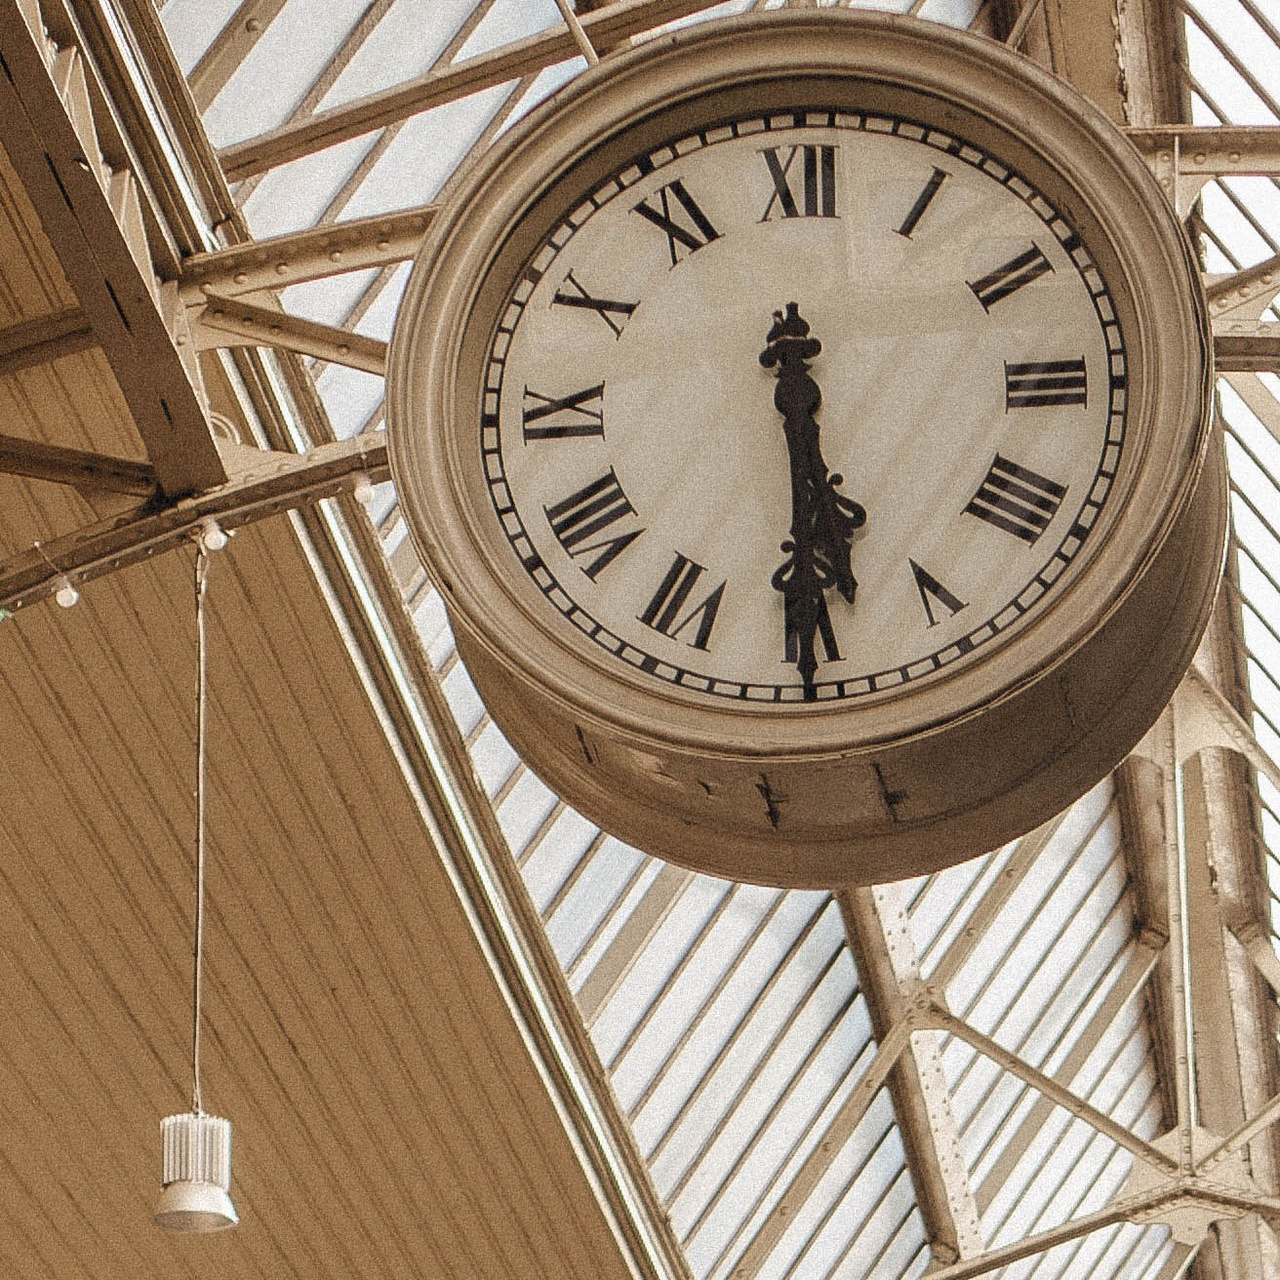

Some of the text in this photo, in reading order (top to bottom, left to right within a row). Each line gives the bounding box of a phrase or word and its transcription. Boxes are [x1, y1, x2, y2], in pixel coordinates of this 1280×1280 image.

[757, 144, 841, 223] XII
[892, 165, 951, 239] I
[630, 177, 724, 270] XI
[550, 268, 640, 338] X
[966, 242, 1056, 314] II
[522, 380, 606, 446] IX
[1004, 356, 1089, 413] III
[544, 466, 646, 582] VIII
[960, 453, 1070, 545] IIII
[636, 551, 727, 652] VII
[909, 557, 969, 628] V
